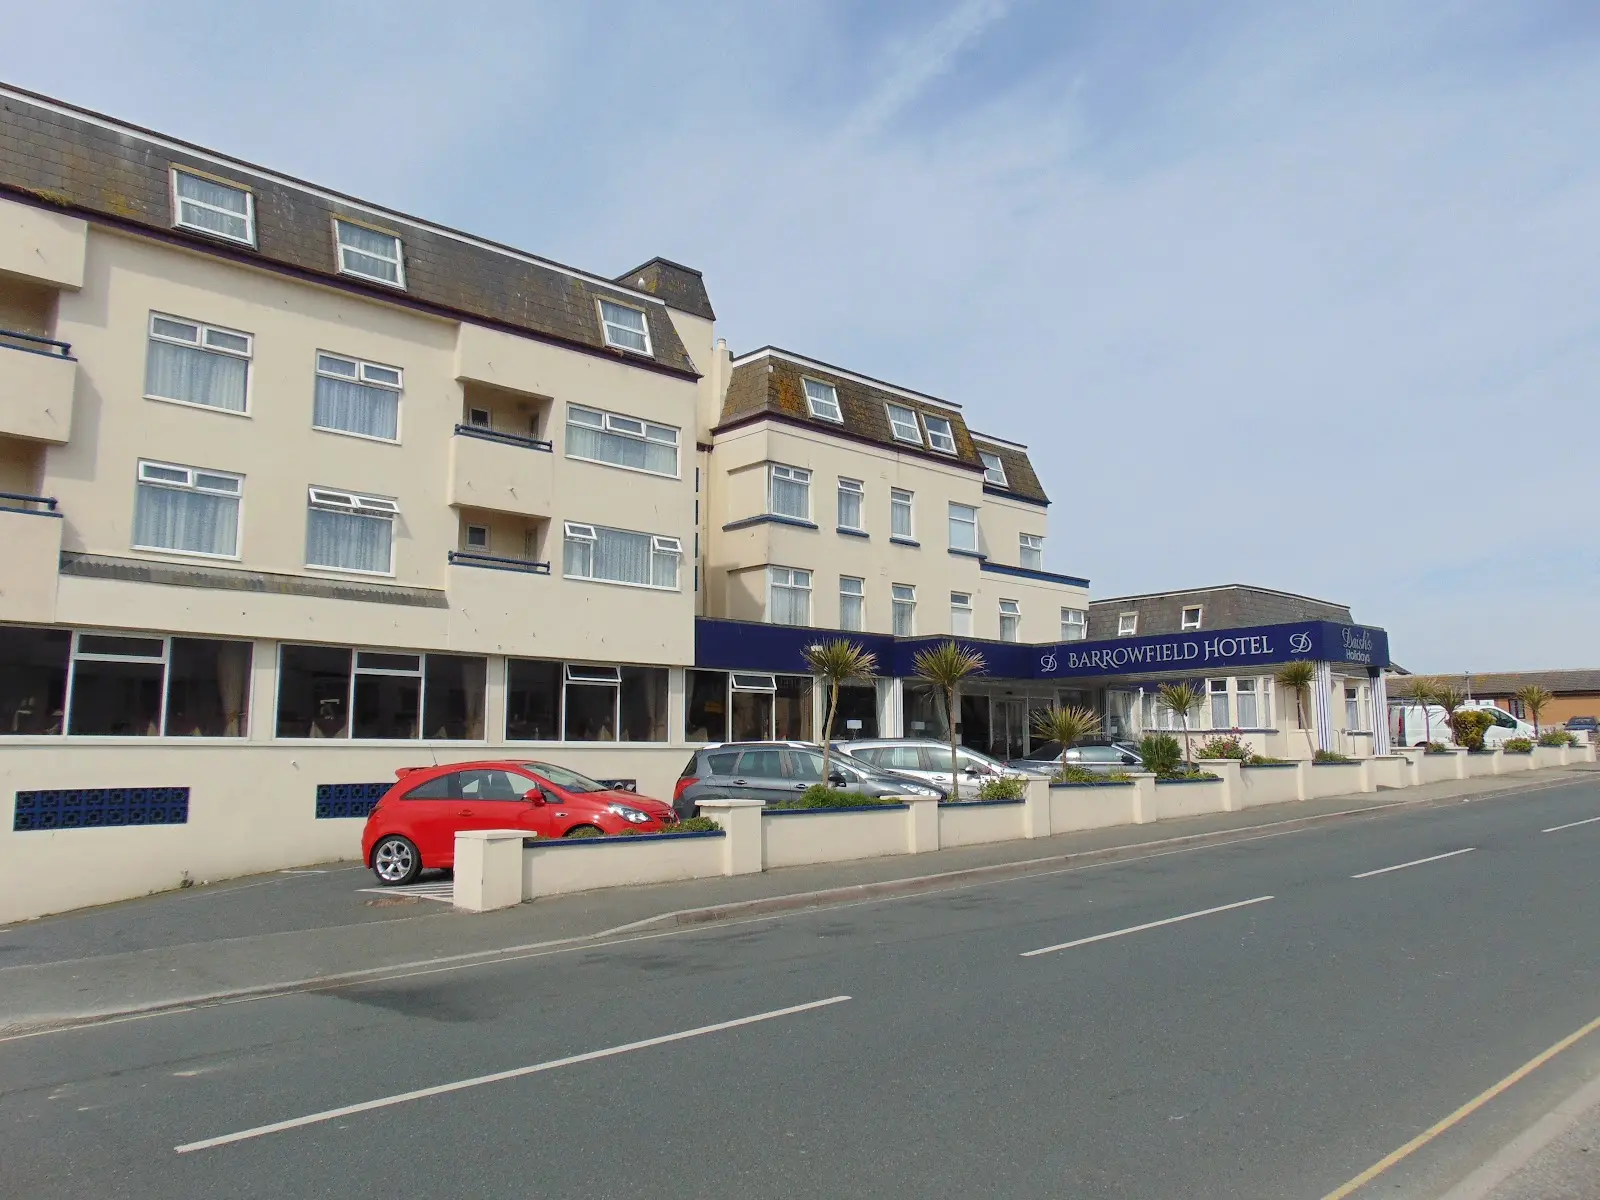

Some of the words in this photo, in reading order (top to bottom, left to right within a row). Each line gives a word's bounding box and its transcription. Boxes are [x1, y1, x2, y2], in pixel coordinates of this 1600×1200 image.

[1068, 642, 1199, 669] BARROWFIELD
[1204, 635, 1274, 661] HOTEL
[1346, 649, 1371, 664] Holidays
